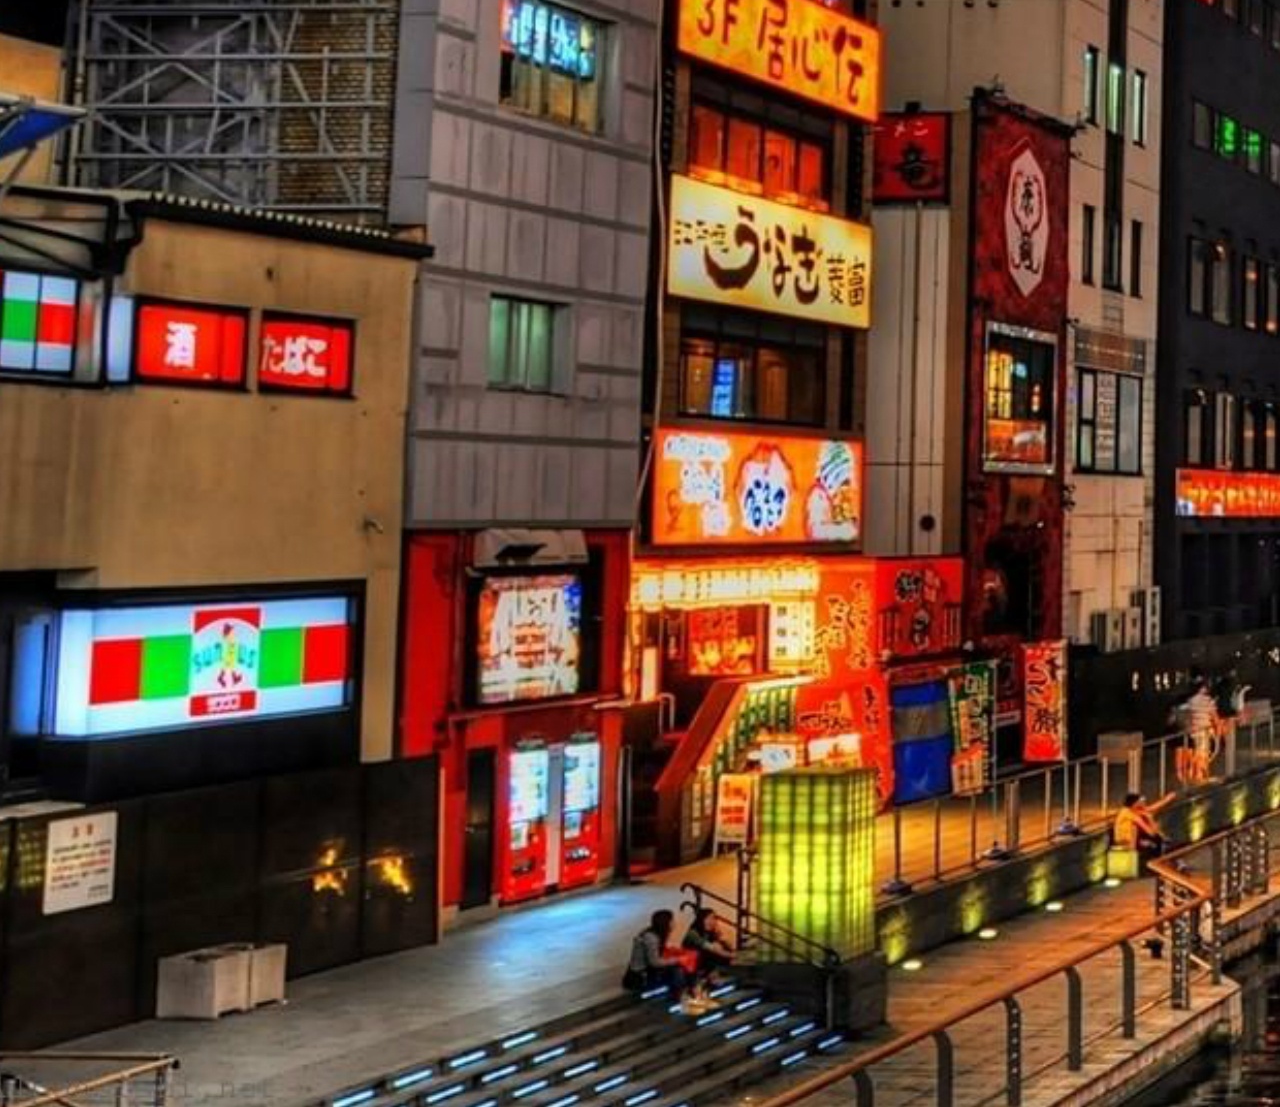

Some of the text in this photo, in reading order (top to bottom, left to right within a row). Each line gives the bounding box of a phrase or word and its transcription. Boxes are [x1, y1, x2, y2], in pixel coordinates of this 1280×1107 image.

[704, 204, 824, 306] うなぎ
[261, 333, 329, 378] たばこ
